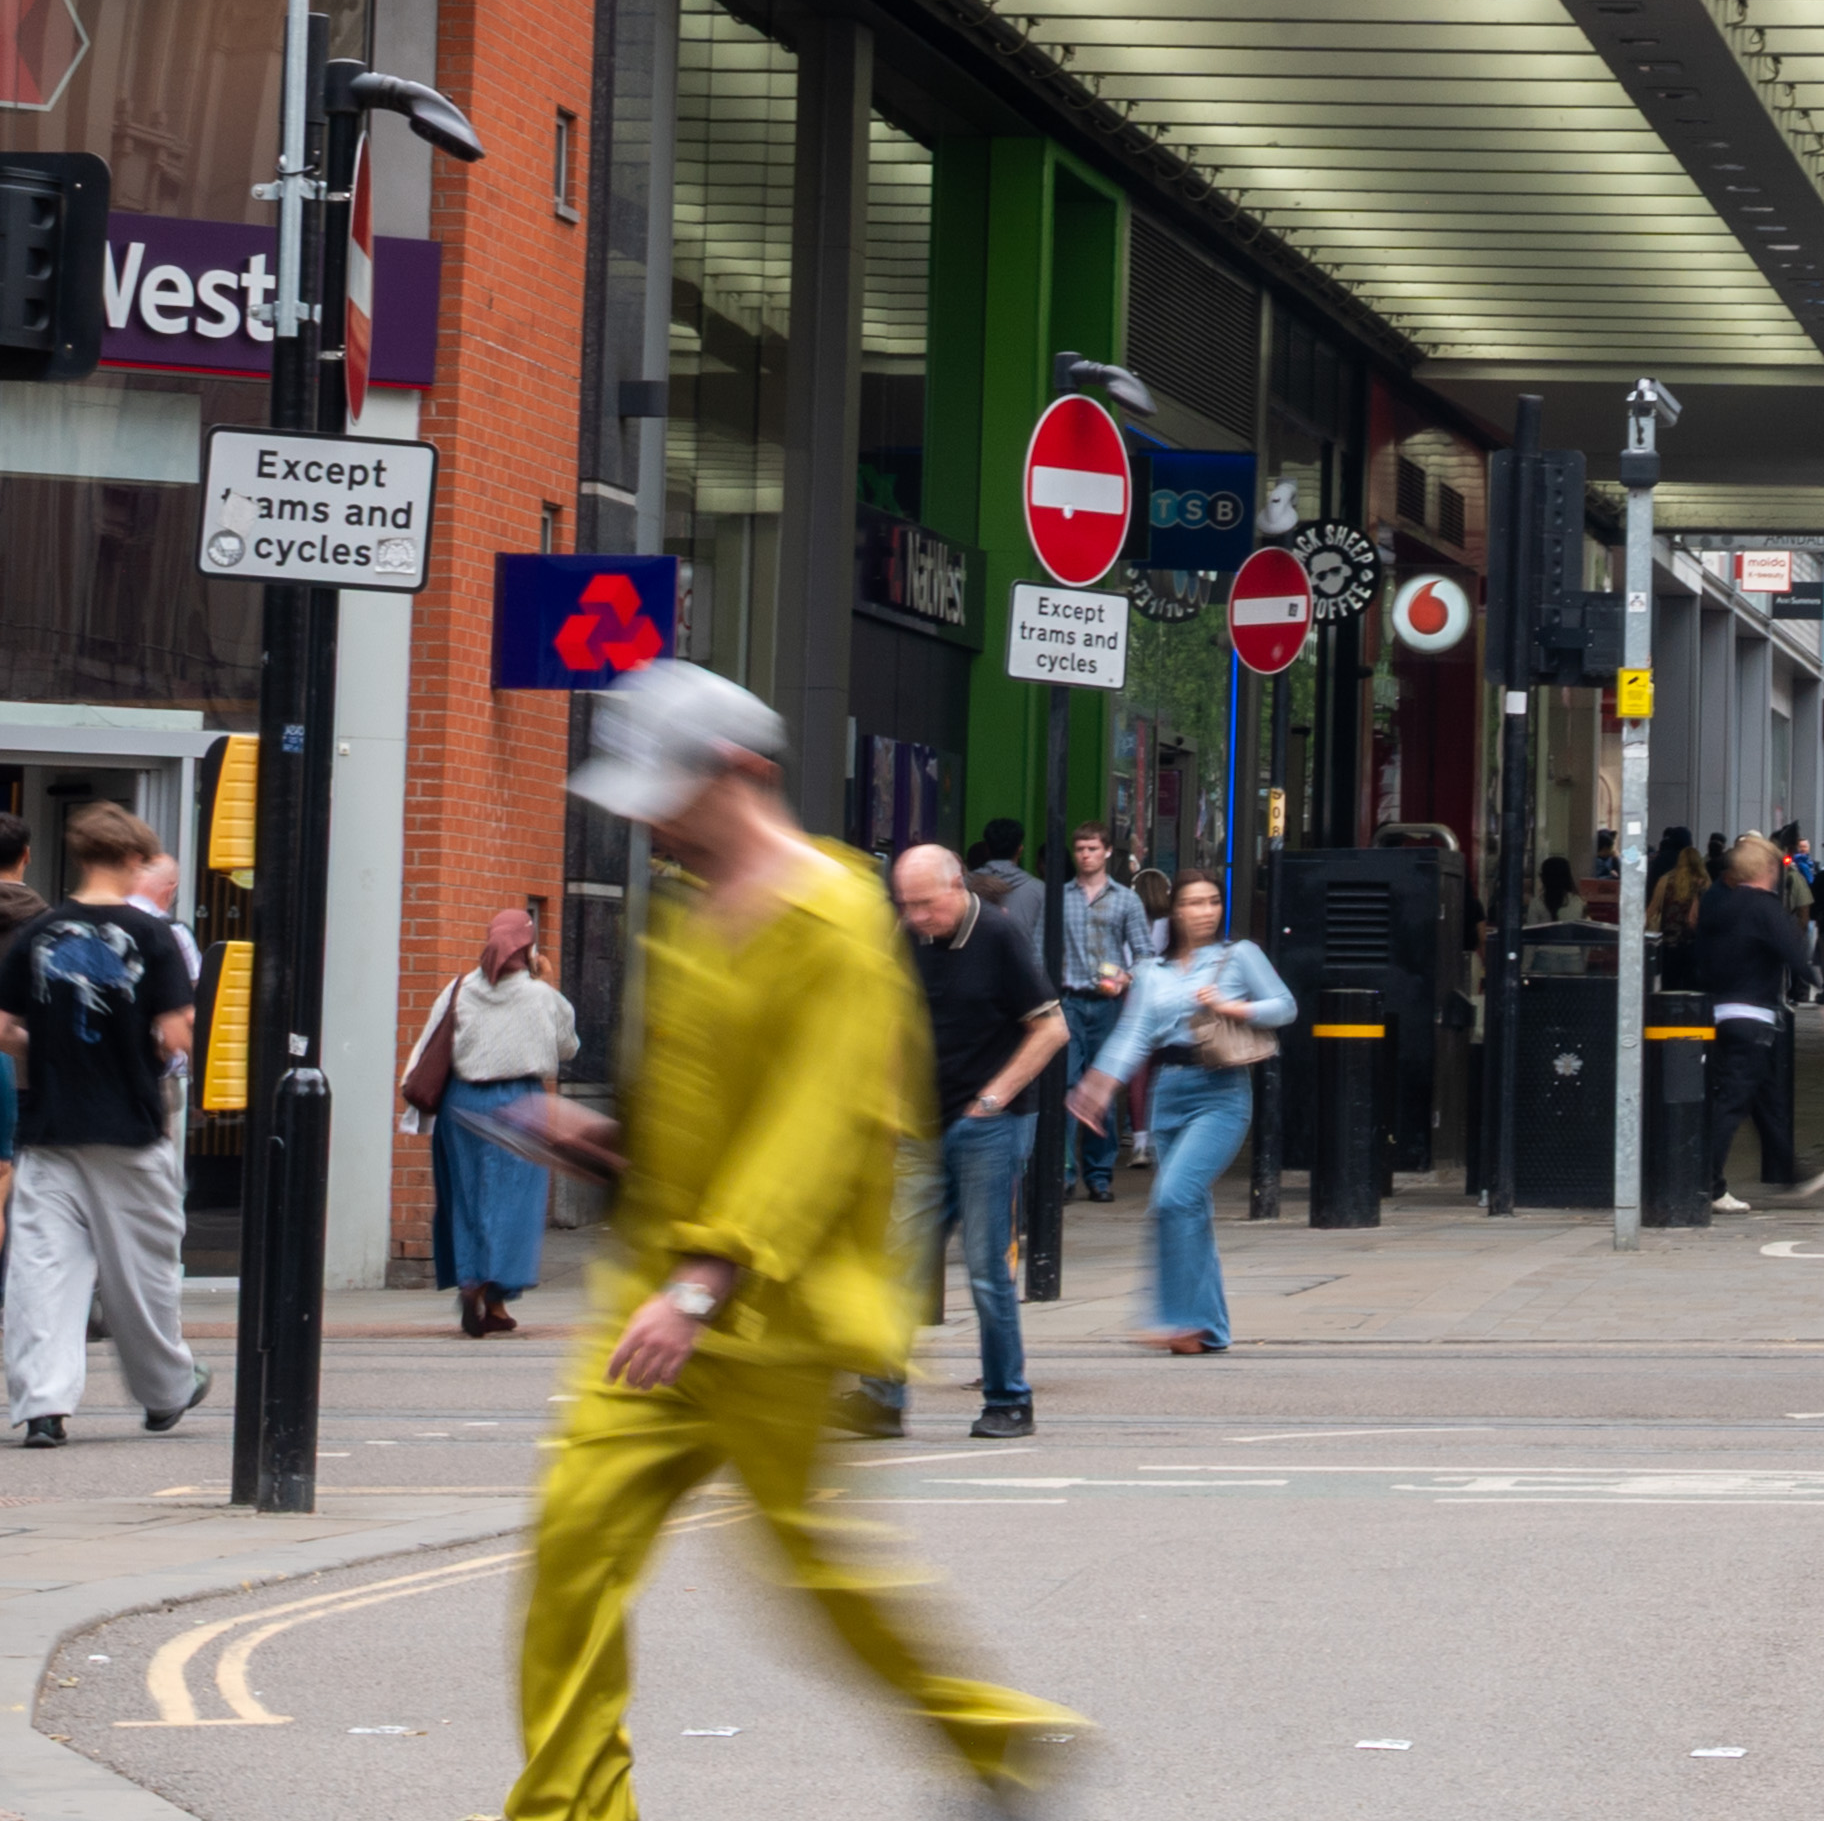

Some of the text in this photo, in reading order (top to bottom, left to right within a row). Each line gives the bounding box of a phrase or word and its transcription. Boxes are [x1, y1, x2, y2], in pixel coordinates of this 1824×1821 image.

[257, 449, 387, 491] Except
[221, 487, 413, 529] ams and
[1157, 497, 1235, 521] TSB
[254, 535, 371, 566] cycles
[1325, 524, 1375, 566] SHEEP
[906, 531, 967, 627] NatWest
[1038, 596, 1105, 624] Except
[1020, 621, 1118, 650] trams and
[1036, 652, 1098, 674] cycles
